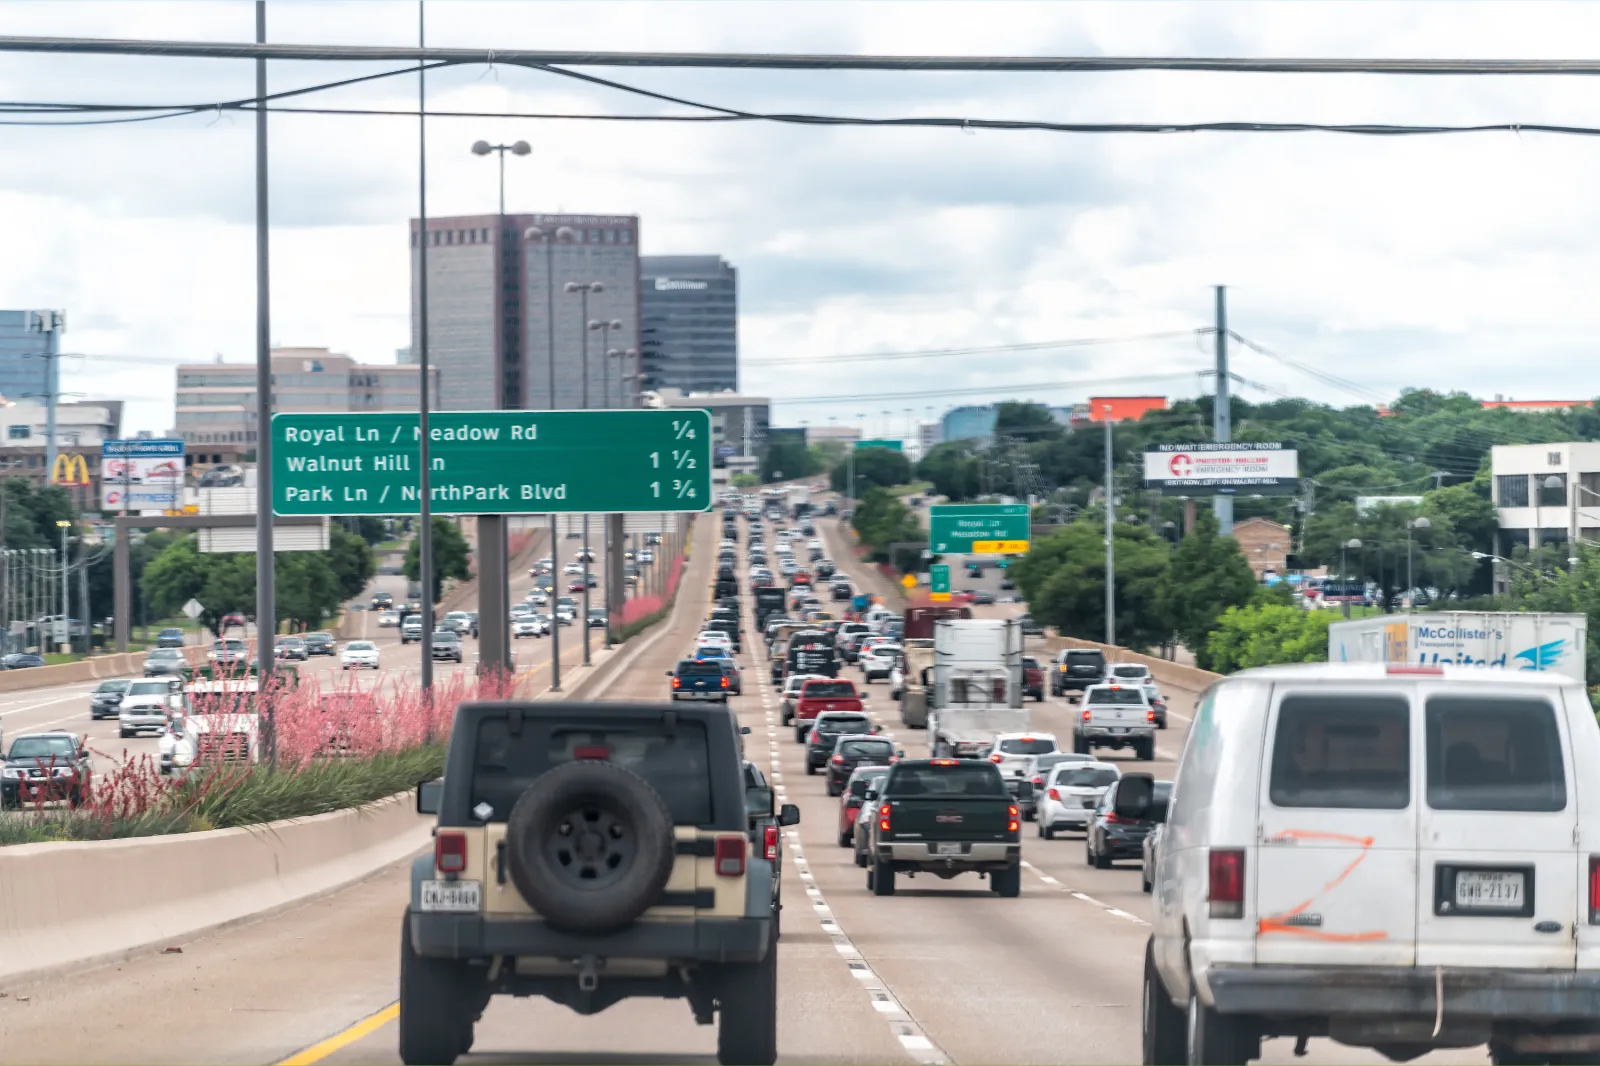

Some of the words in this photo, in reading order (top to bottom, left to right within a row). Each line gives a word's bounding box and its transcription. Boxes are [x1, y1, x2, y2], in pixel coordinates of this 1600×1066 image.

[285, 426, 345, 446] Royal
[356, 427, 380, 441] Ln
[390, 426, 402, 443] /
[511, 424, 537, 440] Rd
[286, 455, 363, 472] Walnut
[374, 455, 411, 471] Hill
[428, 457, 446, 471] n
[649, 452, 660, 469] 1
[285, 486, 333, 501] Park
[344, 486, 368, 501] Ln
[378, 485, 390, 503] /
[520, 483, 567, 500] Blvd
[649, 481, 661, 498] 1
[1418, 626, 1503, 640] McCollister's
